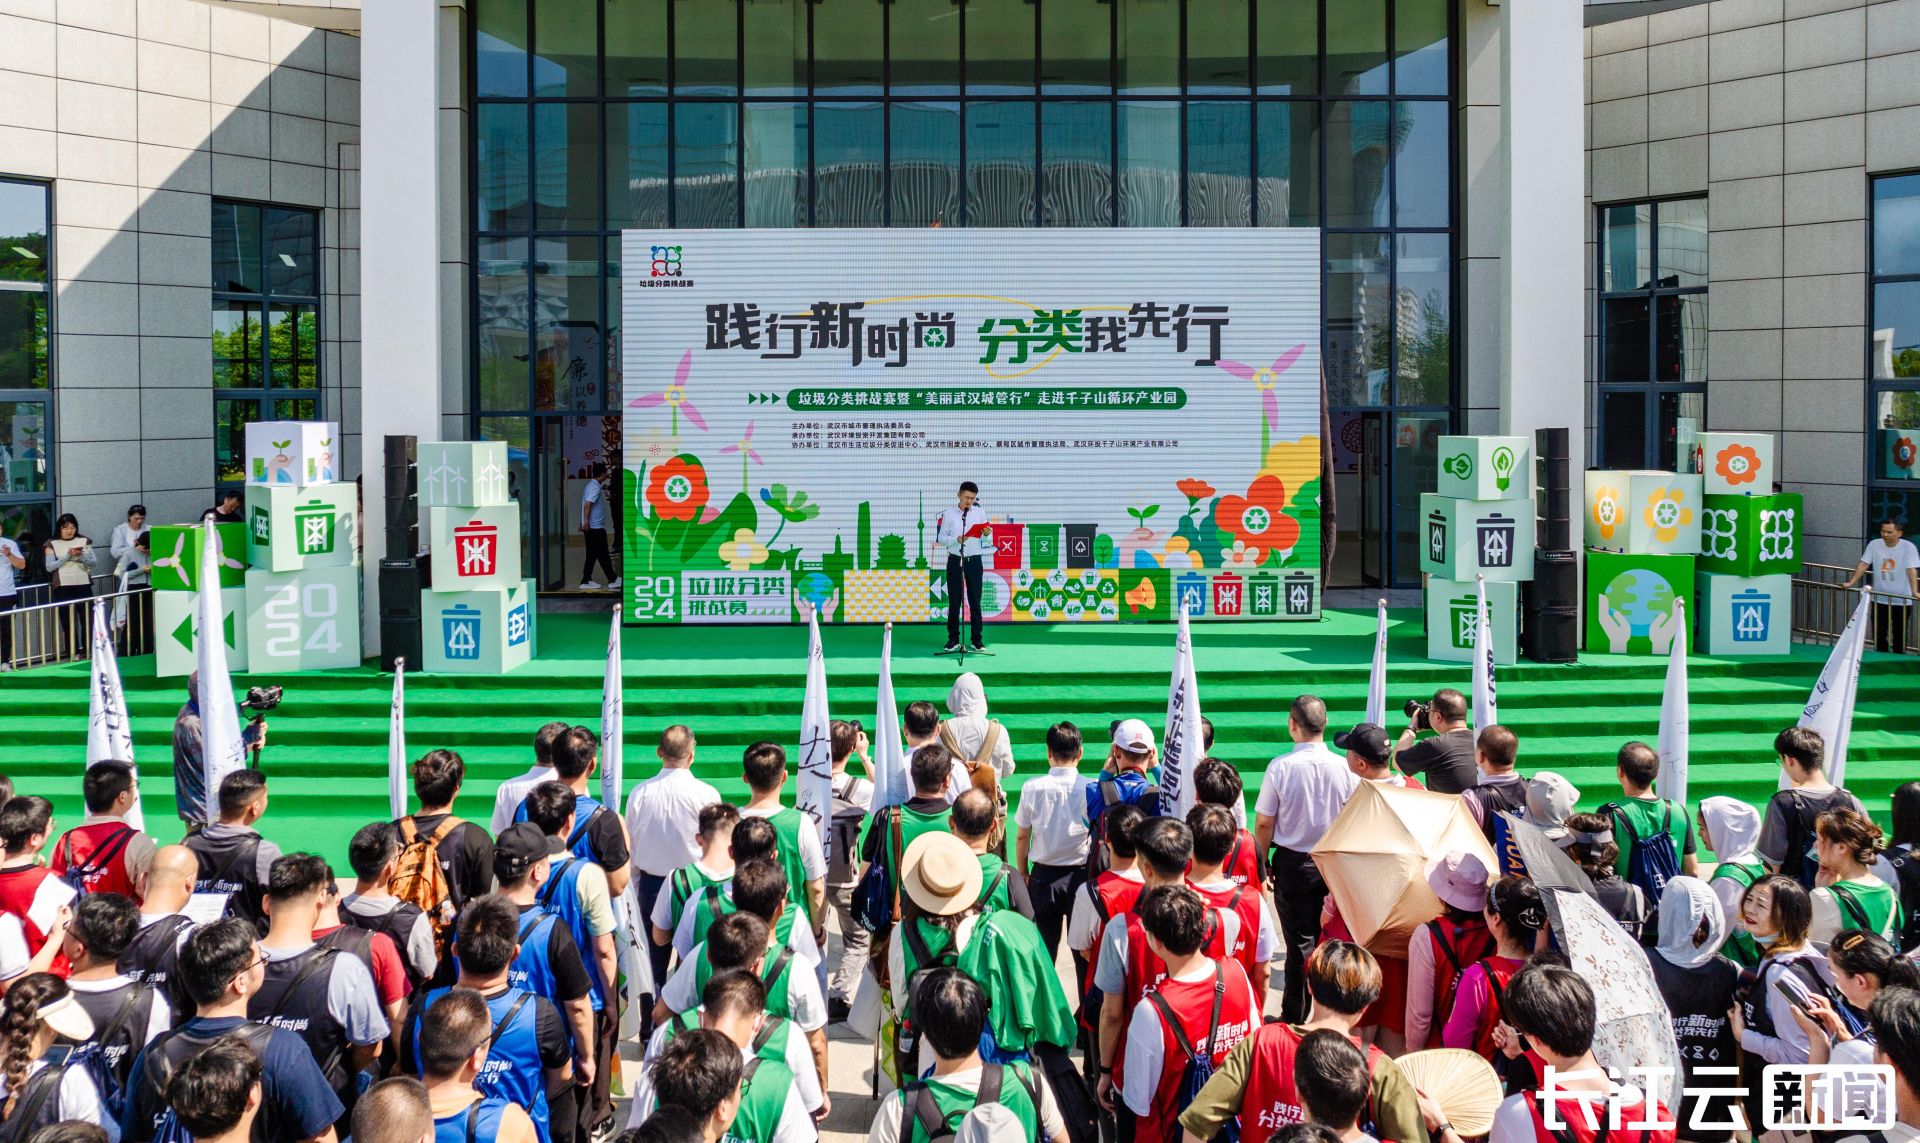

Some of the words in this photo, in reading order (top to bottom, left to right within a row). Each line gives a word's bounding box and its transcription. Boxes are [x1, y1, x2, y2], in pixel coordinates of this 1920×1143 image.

[706, 302, 956, 367] 践行新时尚
[978, 302, 1229, 366] 分类我先行
[688, 577, 785, 596] 垃圾分类
[688, 600, 748, 615] 挑战赛
[1274, 1101, 1305, 1120] 践行
